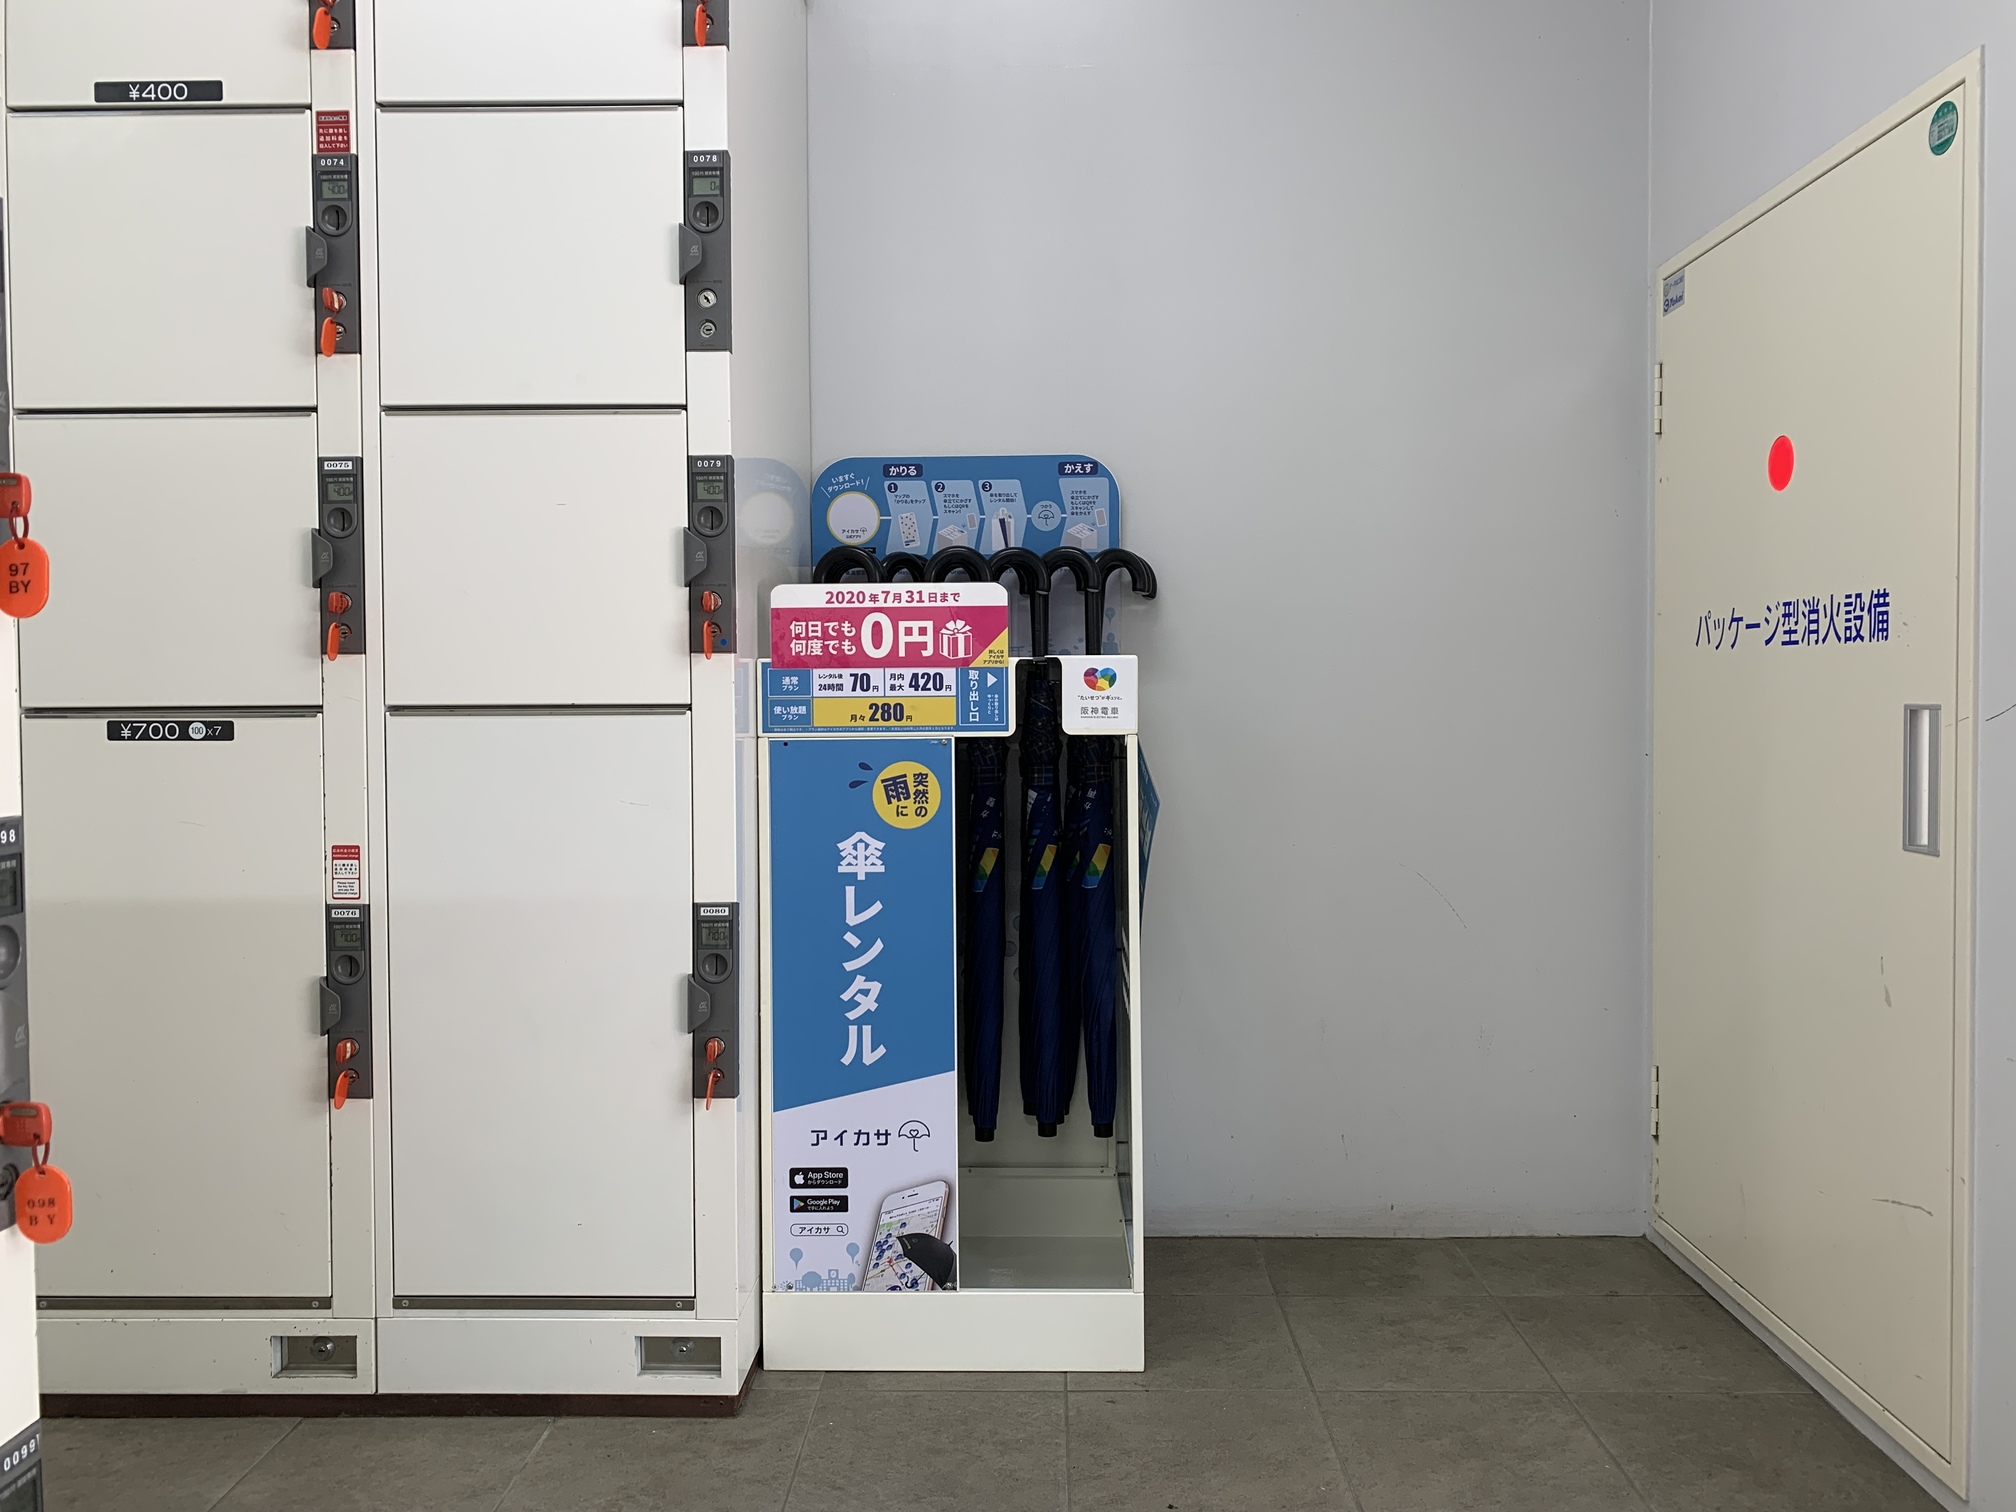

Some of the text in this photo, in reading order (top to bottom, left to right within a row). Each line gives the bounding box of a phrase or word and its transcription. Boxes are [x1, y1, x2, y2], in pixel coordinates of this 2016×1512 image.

[129, 83, 189, 101] ¥400
[320, 158, 345, 166] 0074
[693, 154, 717, 163] 0078
[888, 465, 917, 476] かりる
[1064, 463, 1094, 474] かえす
[831, 472, 856, 484] いますぐ
[9, 562, 30, 577] 97
[9, 579, 31, 594] BY
[825, 590, 961, 605] 2020年7月31日まで
[1695, 587, 1890, 651] パッケージ型消火設備
[789, 620, 857, 638] 何日でも
[861, 611, 934, 659] 0円
[789, 638, 857, 656] 何度でも
[782, 676, 799, 685] 通常
[849, 672, 879, 693] 70円
[889, 673, 905, 681] 月内
[908, 671, 952, 692] 420円
[818, 683, 844, 692] 24時間
[889, 683, 905, 692] 最大
[968, 669, 980, 723] 取り出し口
[774, 705, 807, 715] 使い放題
[1080, 706, 1119, 716] 阪神電車
[120, 722, 179, 740] ¥700
[190, 726, 204, 735] 100
[880, 773, 911, 818] 雨に
[912, 772, 929, 818] 突然の
[836, 831, 887, 1066] 傘レンタル
[810, 1128, 892, 1147] アイカサ
[807, 1171, 844, 1180] App Store
[27, 1197, 56, 1209] 098
[806, 1198, 841, 1207] Google Play
[798, 1226, 830, 1234] アイカサ
[3, 1438, 36, 1472] 0099
